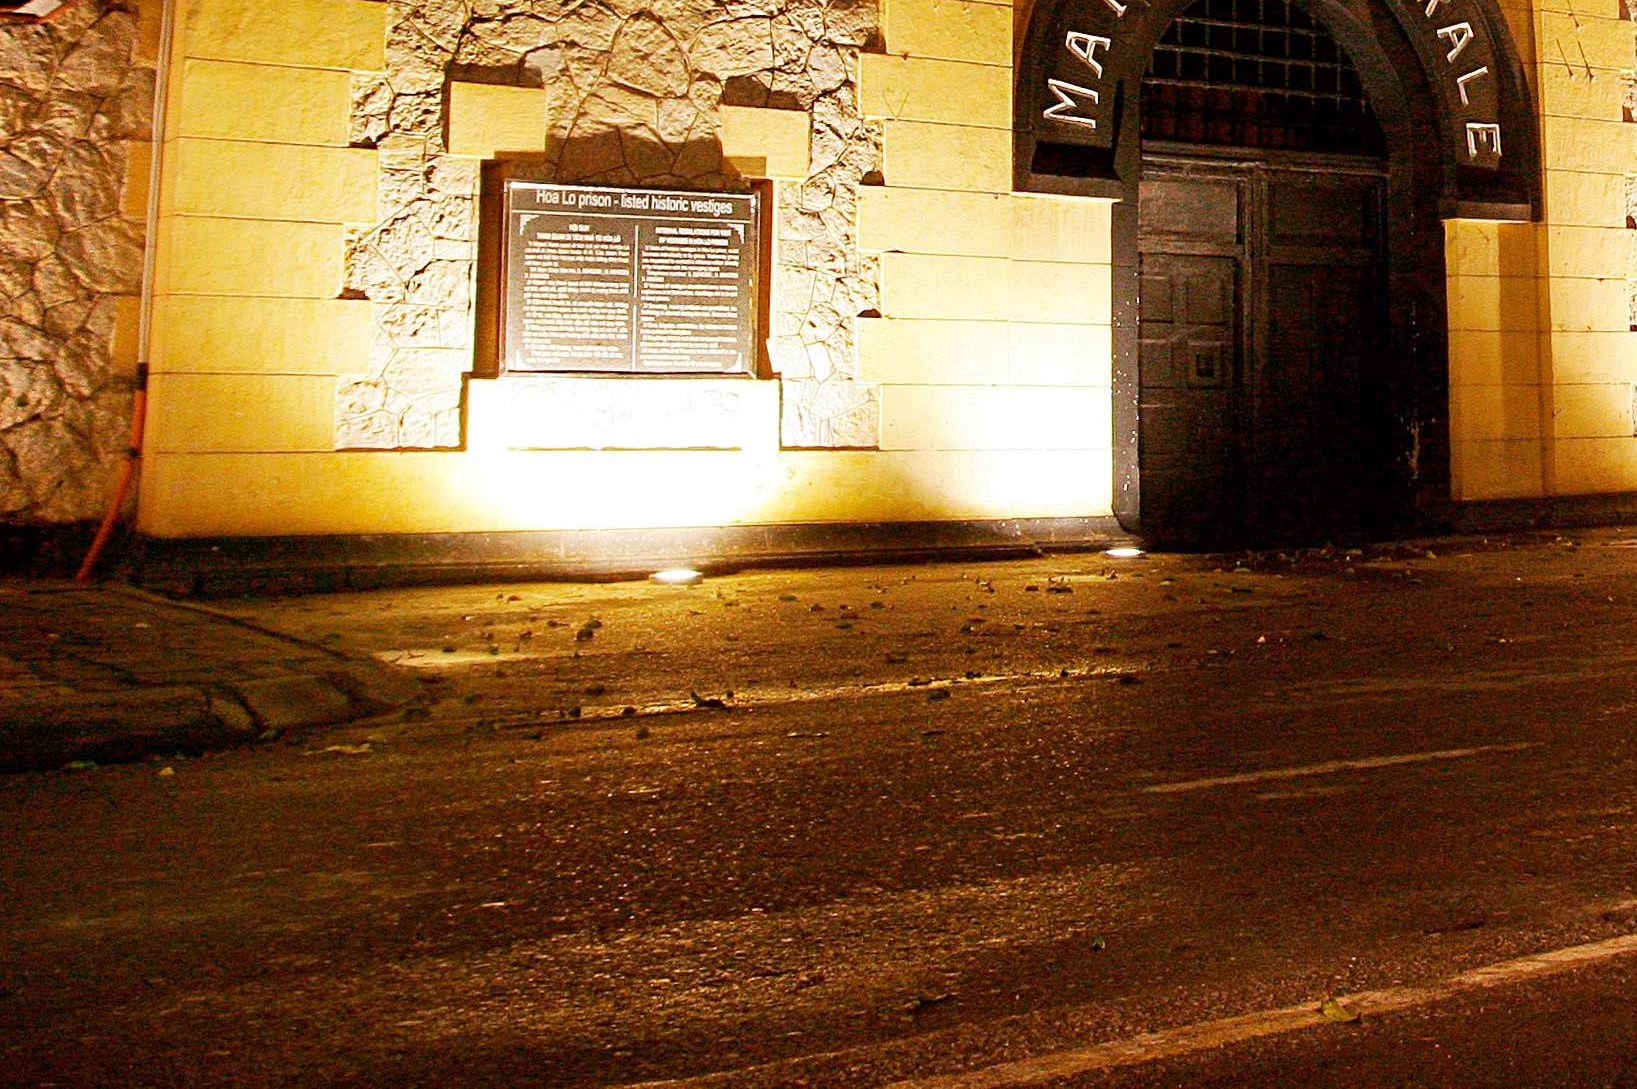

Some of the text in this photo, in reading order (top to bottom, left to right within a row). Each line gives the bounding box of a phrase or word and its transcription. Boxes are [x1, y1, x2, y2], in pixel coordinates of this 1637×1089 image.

[536, 189, 559, 204] Hoa
[562, 191, 576, 205] Lo
[578, 193, 611, 209] prison
[621, 194, 649, 209] listed
[651, 195, 689, 211] historic
[691, 199, 733, 217] vestiges
